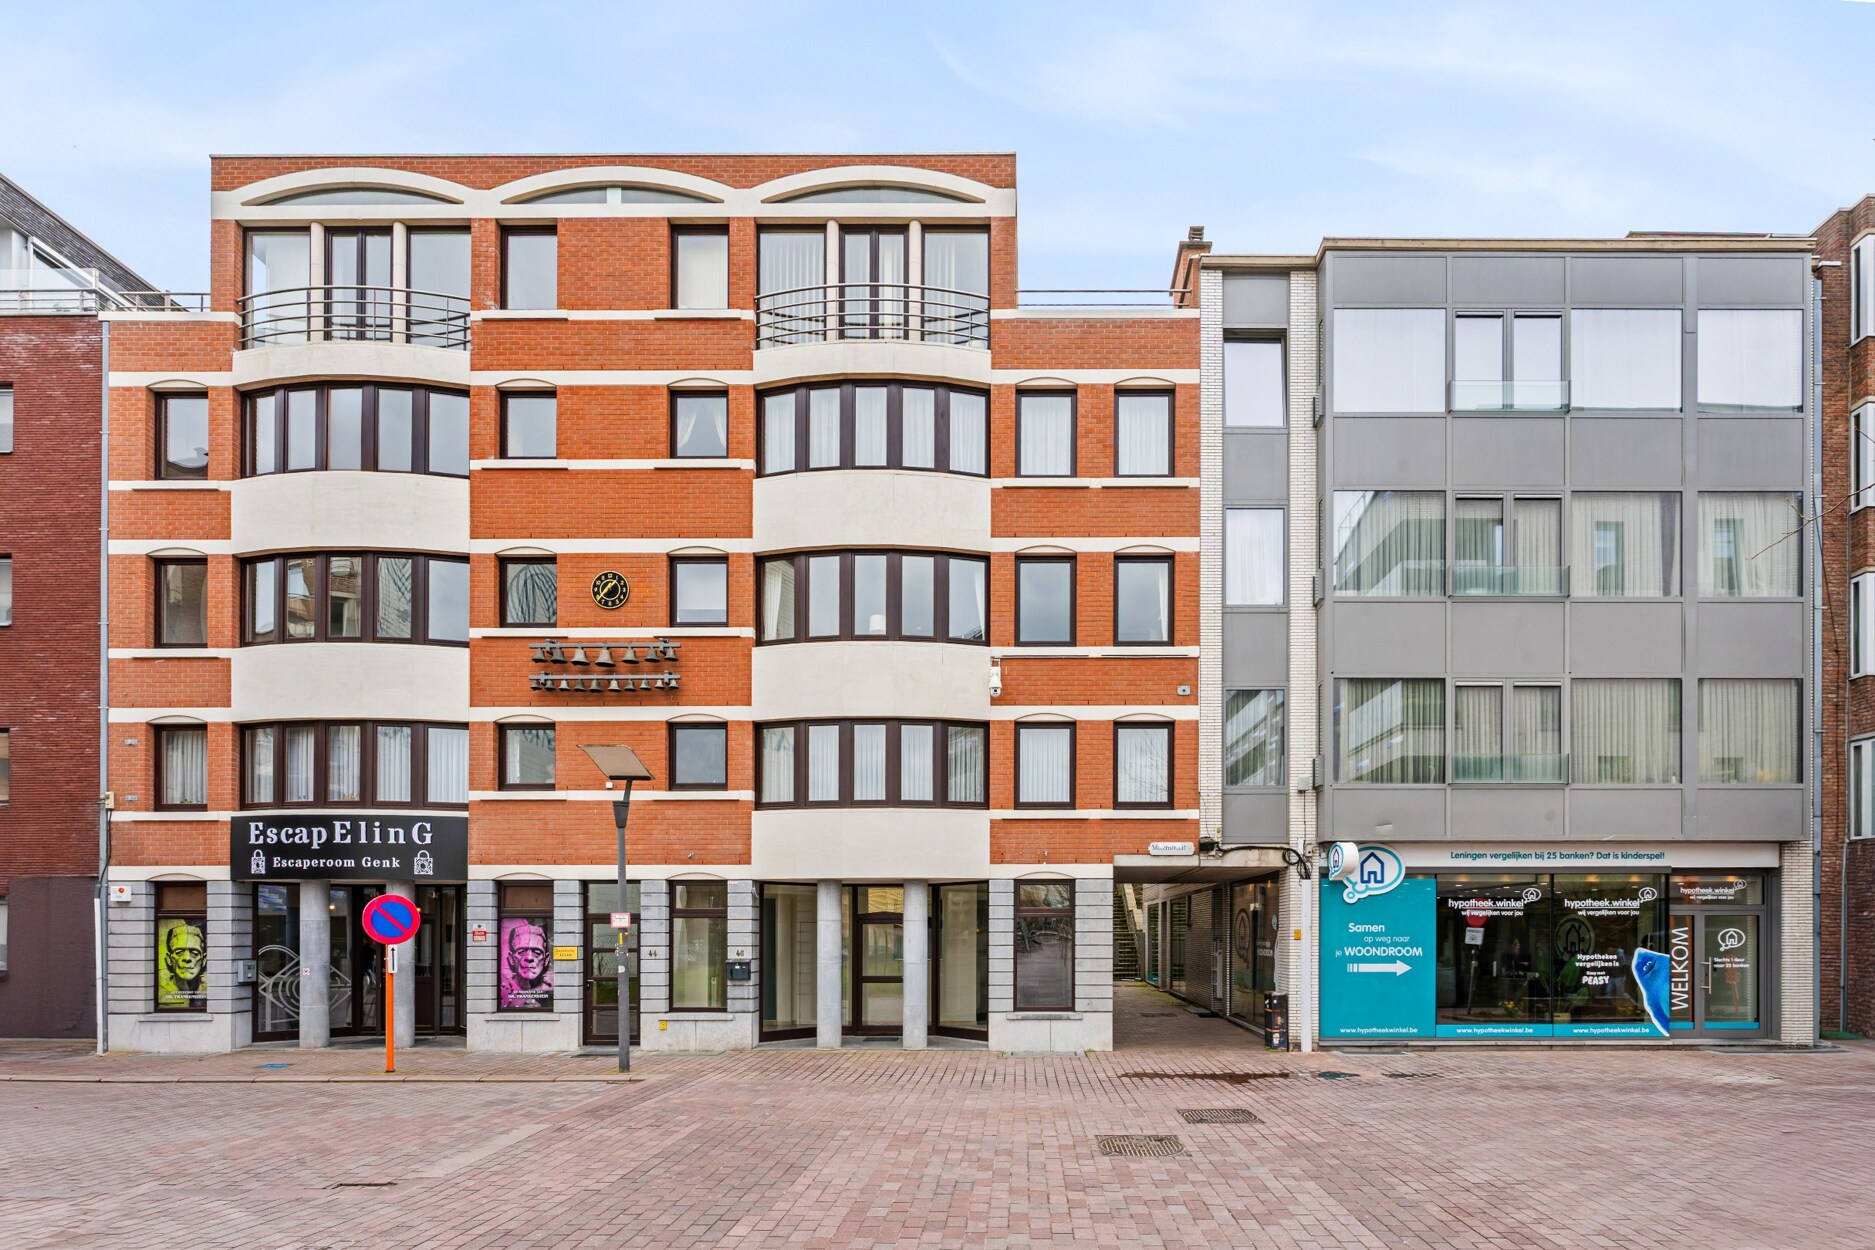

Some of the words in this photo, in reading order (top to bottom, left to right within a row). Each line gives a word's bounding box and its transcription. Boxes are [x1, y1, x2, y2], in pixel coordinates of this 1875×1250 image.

[1450, 851, 1487, 861] Leningen
[1489, 851, 1532, 861] vergelijken
[1534, 851, 1545, 861] bij
[1546, 851, 1557, 860] 25
[1559, 851, 1594, 860] banken?
[1596, 851, 1611, 860] Dat
[1612, 851, 1619, 860] is
[1620, 851, 1665, 861] kinderspel!
[272, 856, 355, 870] Escaperoom
[361, 857, 401, 868] Genk
[1680, 887, 1735, 895] hypotheek.winkel
[1448, 898, 1524, 909] hypotheek.winkel
[1564, 898, 1640, 909] hypotheek.winkel
[1348, 922, 1385, 933] Samen
[1363, 936, 1374, 944] op
[1375, 936, 1391, 944] weg
[648, 949, 658, 958] 44
[735, 949, 745, 957] 46
[1335, 949, 1342, 958] je
[1344, 946, 1423, 957] WOONDROOM
[1577, 953, 1618, 961] Hypotheken
[1671, 927, 1689, 1011] WELKOM
[1582, 975, 1610, 985] PEASY
